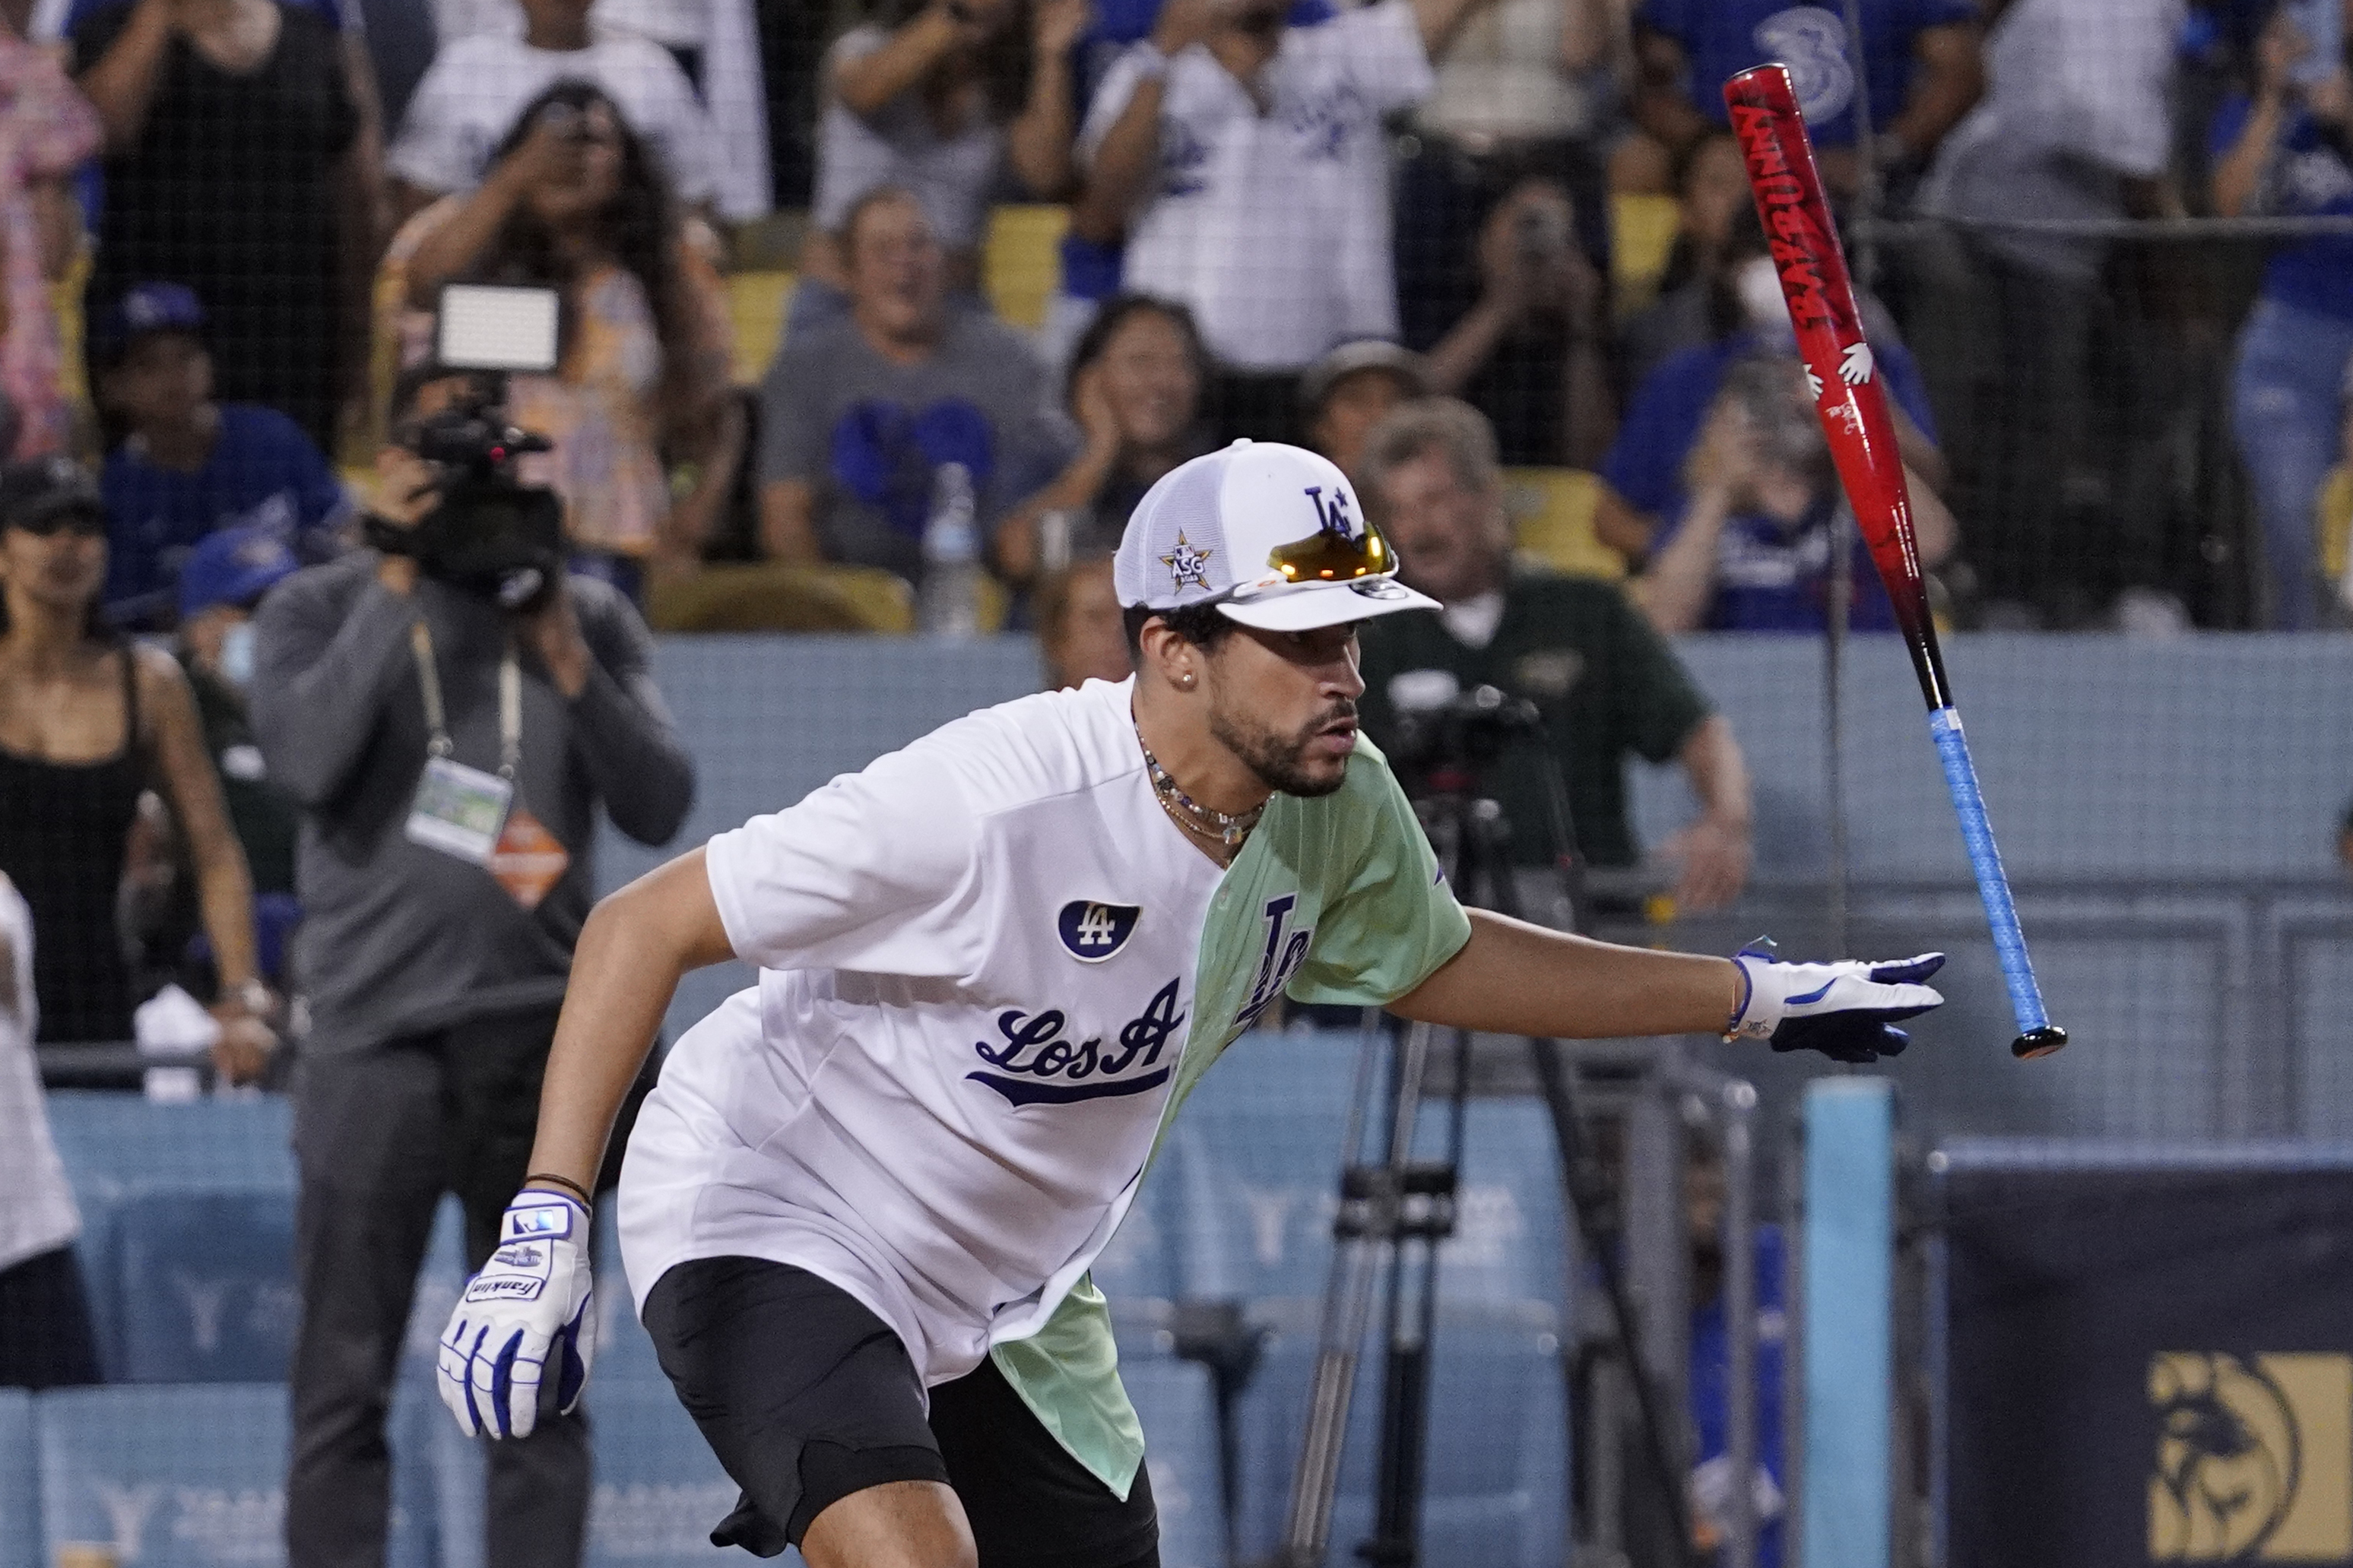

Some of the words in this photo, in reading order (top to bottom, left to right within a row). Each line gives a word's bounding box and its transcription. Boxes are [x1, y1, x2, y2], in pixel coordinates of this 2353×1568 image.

[1172, 556, 1204, 578] ASG
[1077, 901, 1116, 945] LA
[975, 1009, 1101, 1079] Los
[1100, 977, 1185, 1075] A
